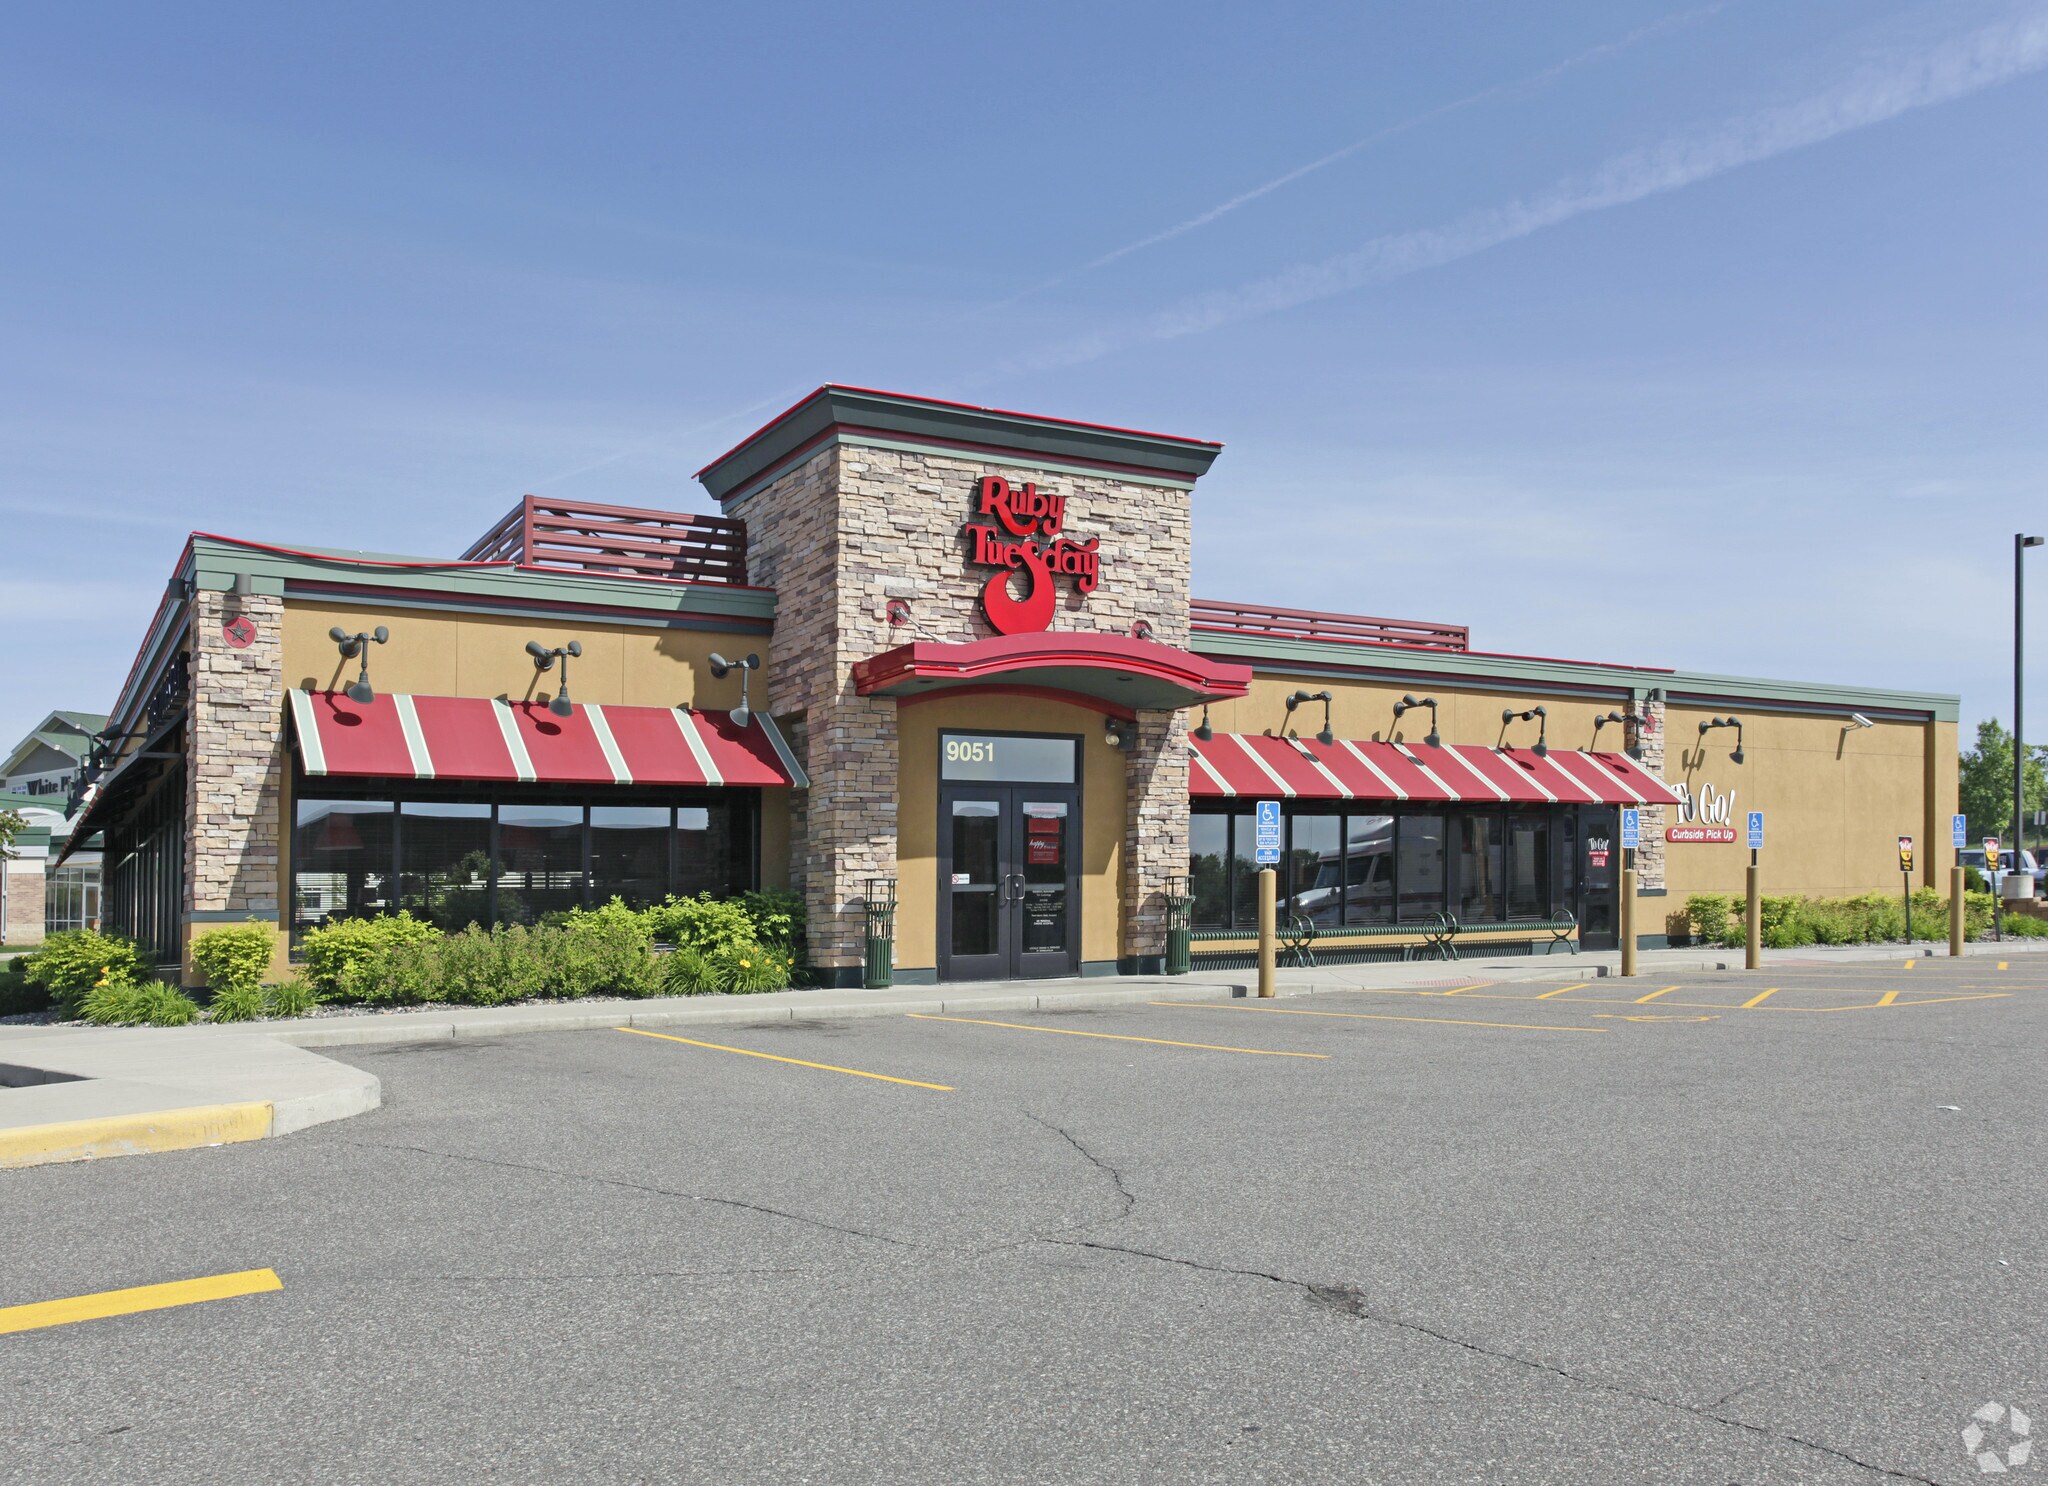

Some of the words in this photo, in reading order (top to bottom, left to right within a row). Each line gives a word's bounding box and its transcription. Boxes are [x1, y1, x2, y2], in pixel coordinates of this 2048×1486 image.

[977, 476, 1066, 536] Ruby
[964, 523, 1100, 635] Tuesday
[946, 741, 993, 762] 9051
[26, 779, 58, 796] White
[1698, 782, 1736, 827] Go!
[1587, 837, 1597, 850] To
[1671, 828, 1704, 839] Curbside
[1706, 829, 1721, 839] Pick
[1723, 830, 1734, 841] Up
